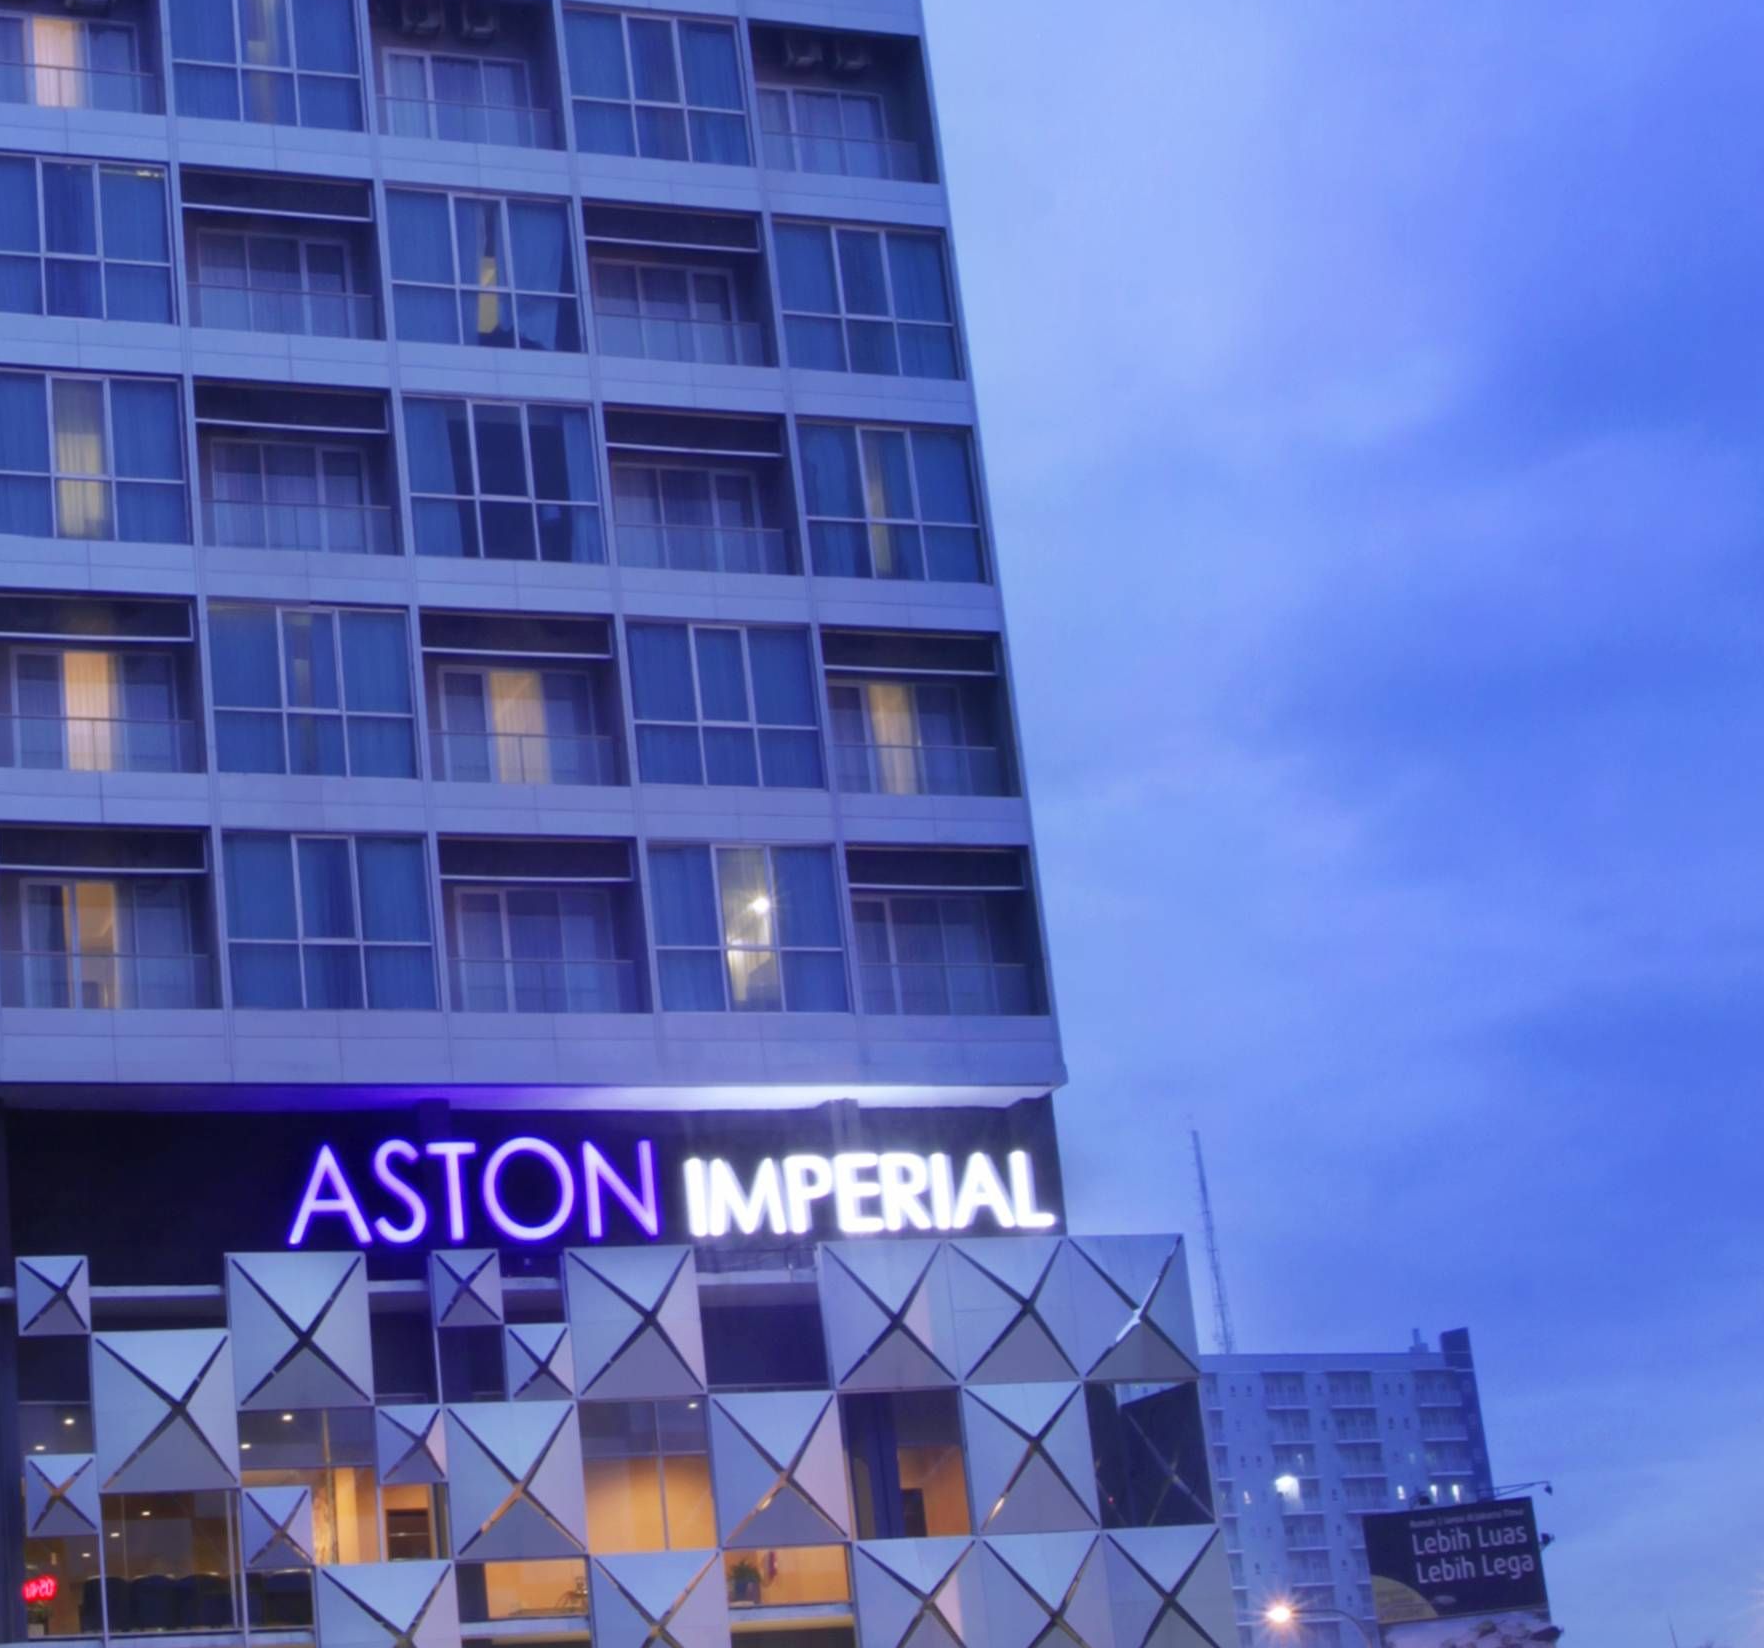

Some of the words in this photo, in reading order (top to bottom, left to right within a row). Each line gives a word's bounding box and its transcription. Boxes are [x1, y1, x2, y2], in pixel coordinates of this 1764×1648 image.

[289, 1137, 660, 1245] ASTON
[683, 1148, 1057, 1238] IMPERIAL
[1412, 1526, 1471, 1555] Lebih
[1477, 1525, 1527, 1548] Luas
[1416, 1555, 1476, 1584] Lebih
[1481, 1553, 1535, 1580] Lega
